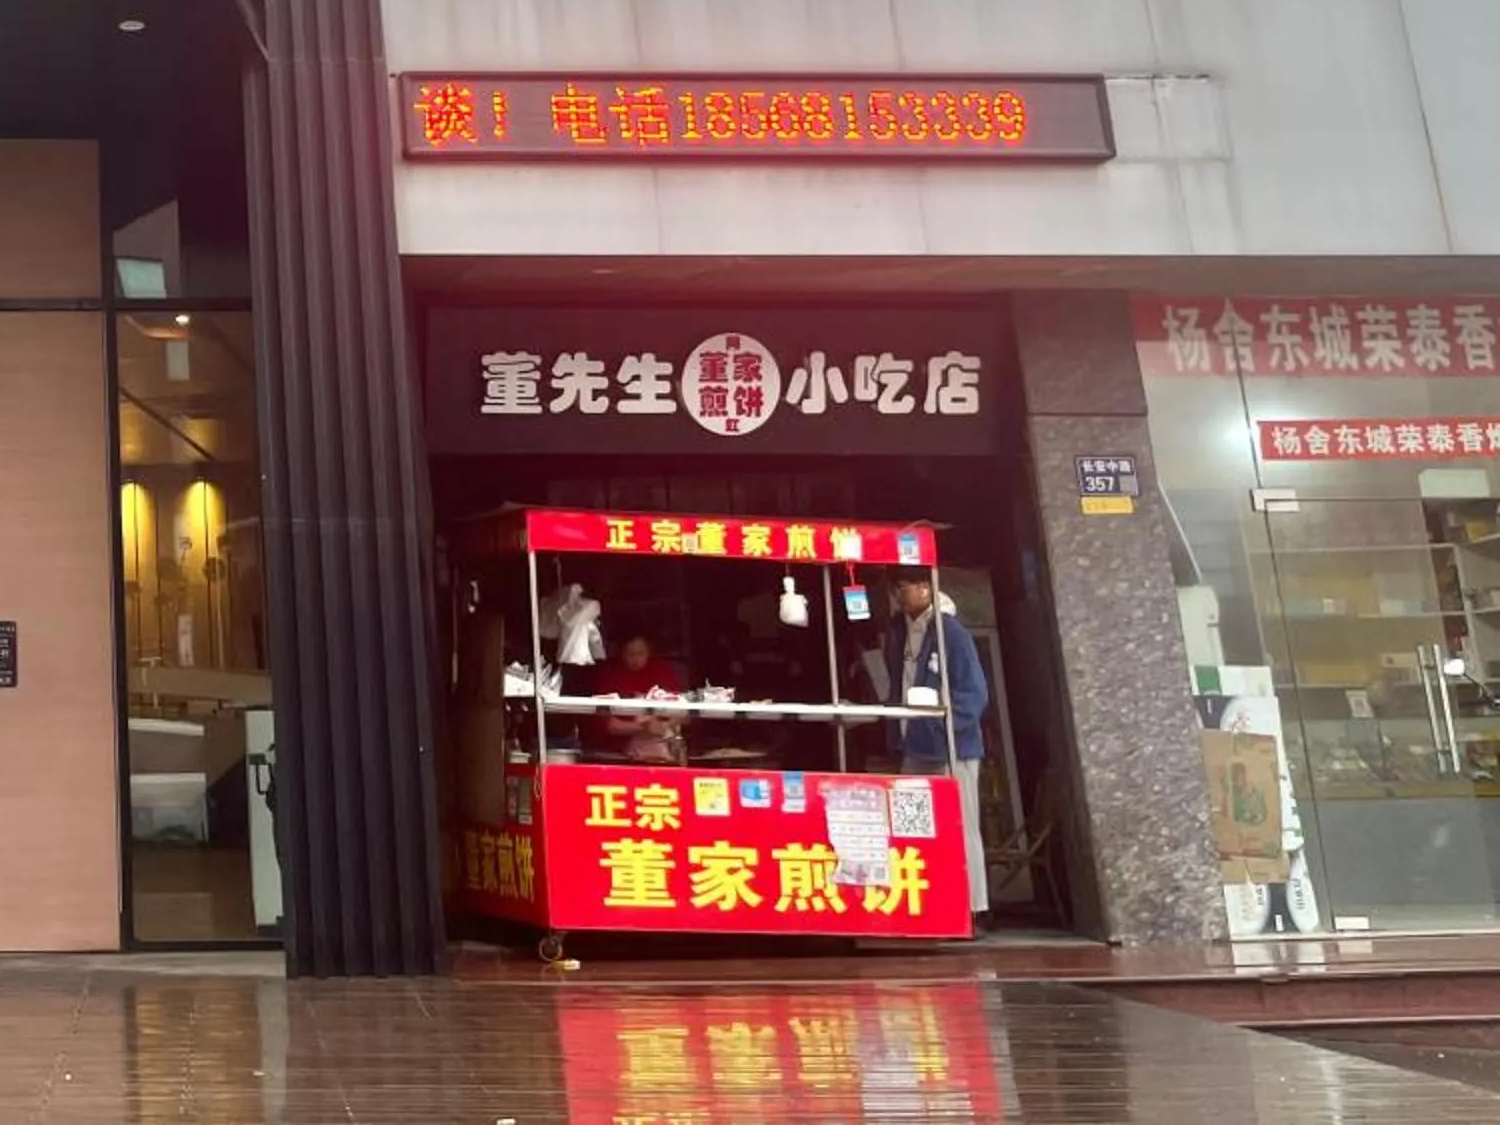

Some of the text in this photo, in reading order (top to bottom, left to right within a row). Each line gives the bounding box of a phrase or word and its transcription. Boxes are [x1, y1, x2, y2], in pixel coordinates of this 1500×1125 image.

[480, 351, 983, 415] 董先生 小吃店
[1086, 476, 1115, 492] 357
[585, 785, 680, 830] 正宗
[600, 838, 930, 915] 董家煎饼
